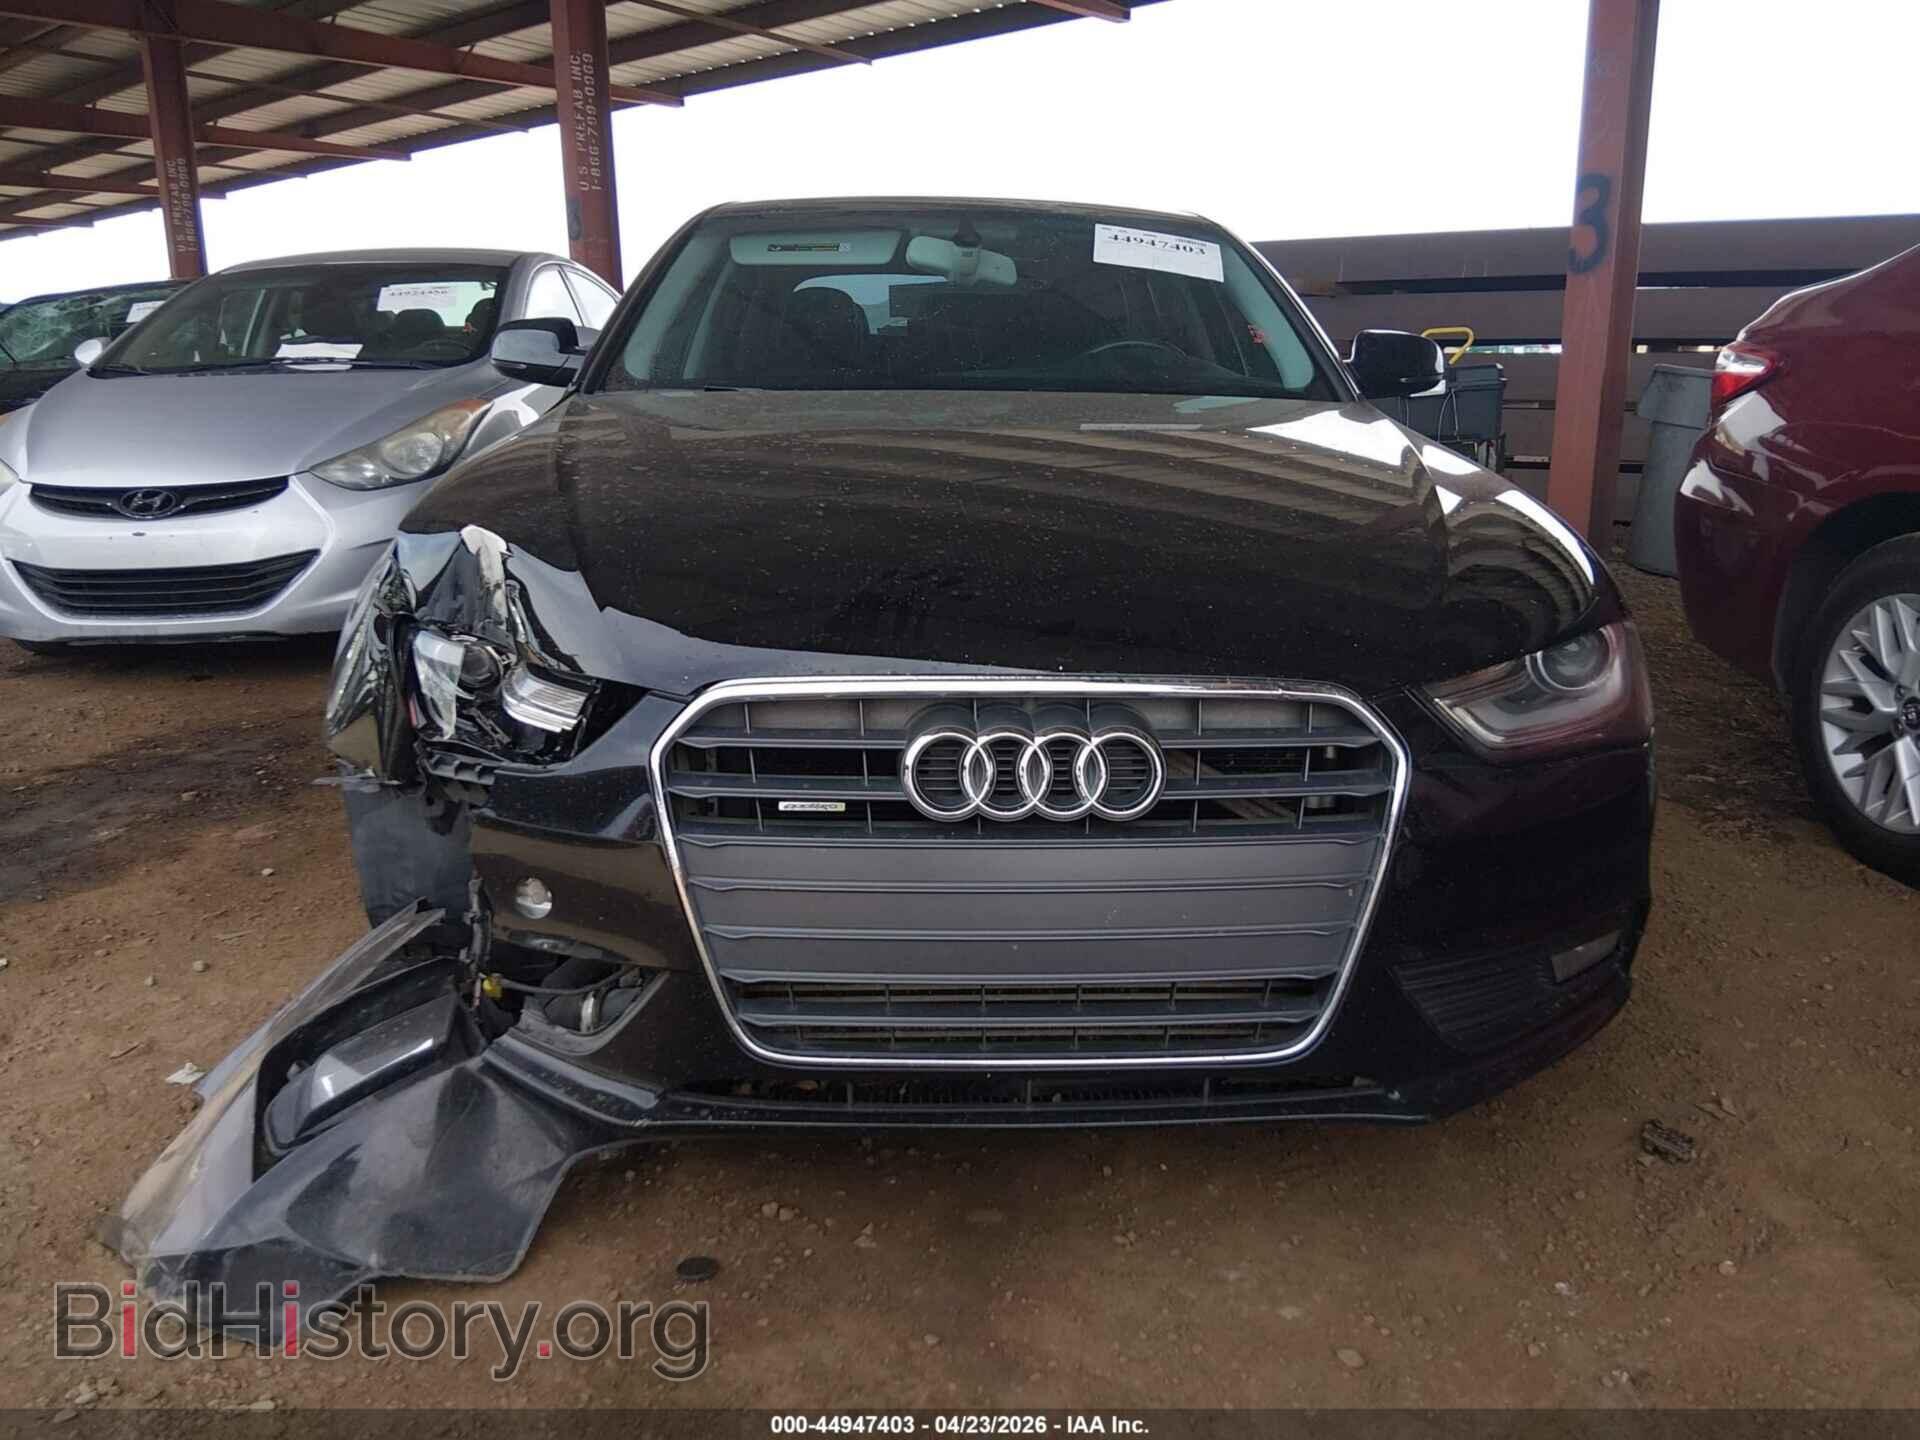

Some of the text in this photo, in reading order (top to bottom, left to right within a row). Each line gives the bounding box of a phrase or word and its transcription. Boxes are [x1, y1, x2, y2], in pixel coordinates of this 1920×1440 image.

[571, 88, 588, 153] PREFAB
[1107, 234, 1206, 255] 44947403
[1567, 172, 1610, 274] 3
